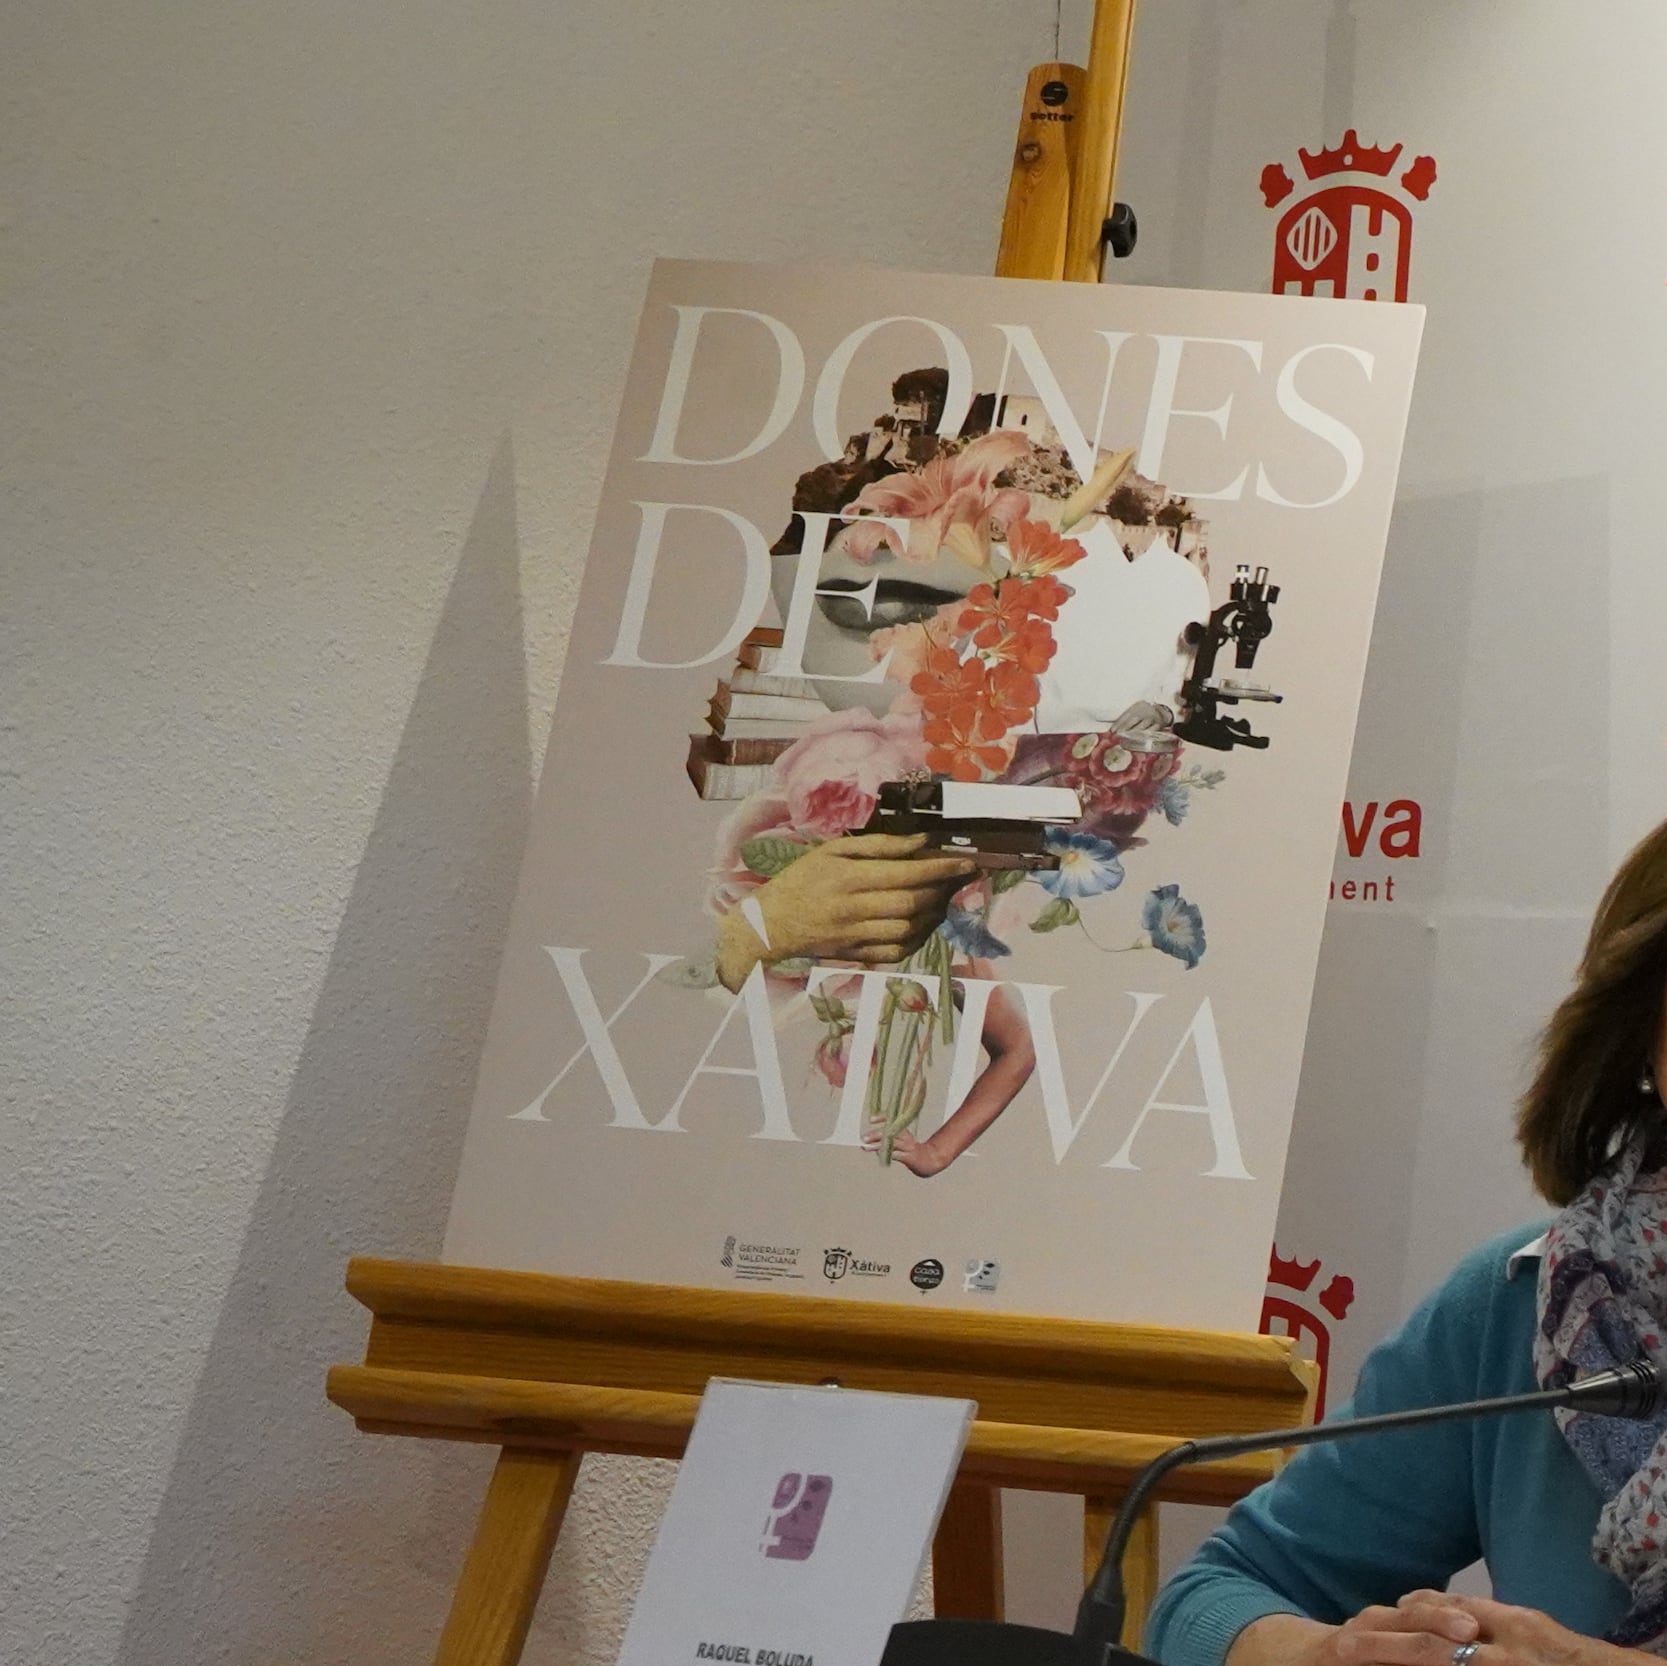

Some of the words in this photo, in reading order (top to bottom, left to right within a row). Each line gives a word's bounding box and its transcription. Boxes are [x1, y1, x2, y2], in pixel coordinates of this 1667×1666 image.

[634, 304, 1376, 509] DONES
[597, 501, 911, 683] DE
[508, 897, 1256, 1182] XÀTIVA
[738, 1244, 801, 1256] GENERALITAT
[738, 1254, 798, 1266] VALENCIANA
[696, 1642, 752, 1665] RAQUEL
